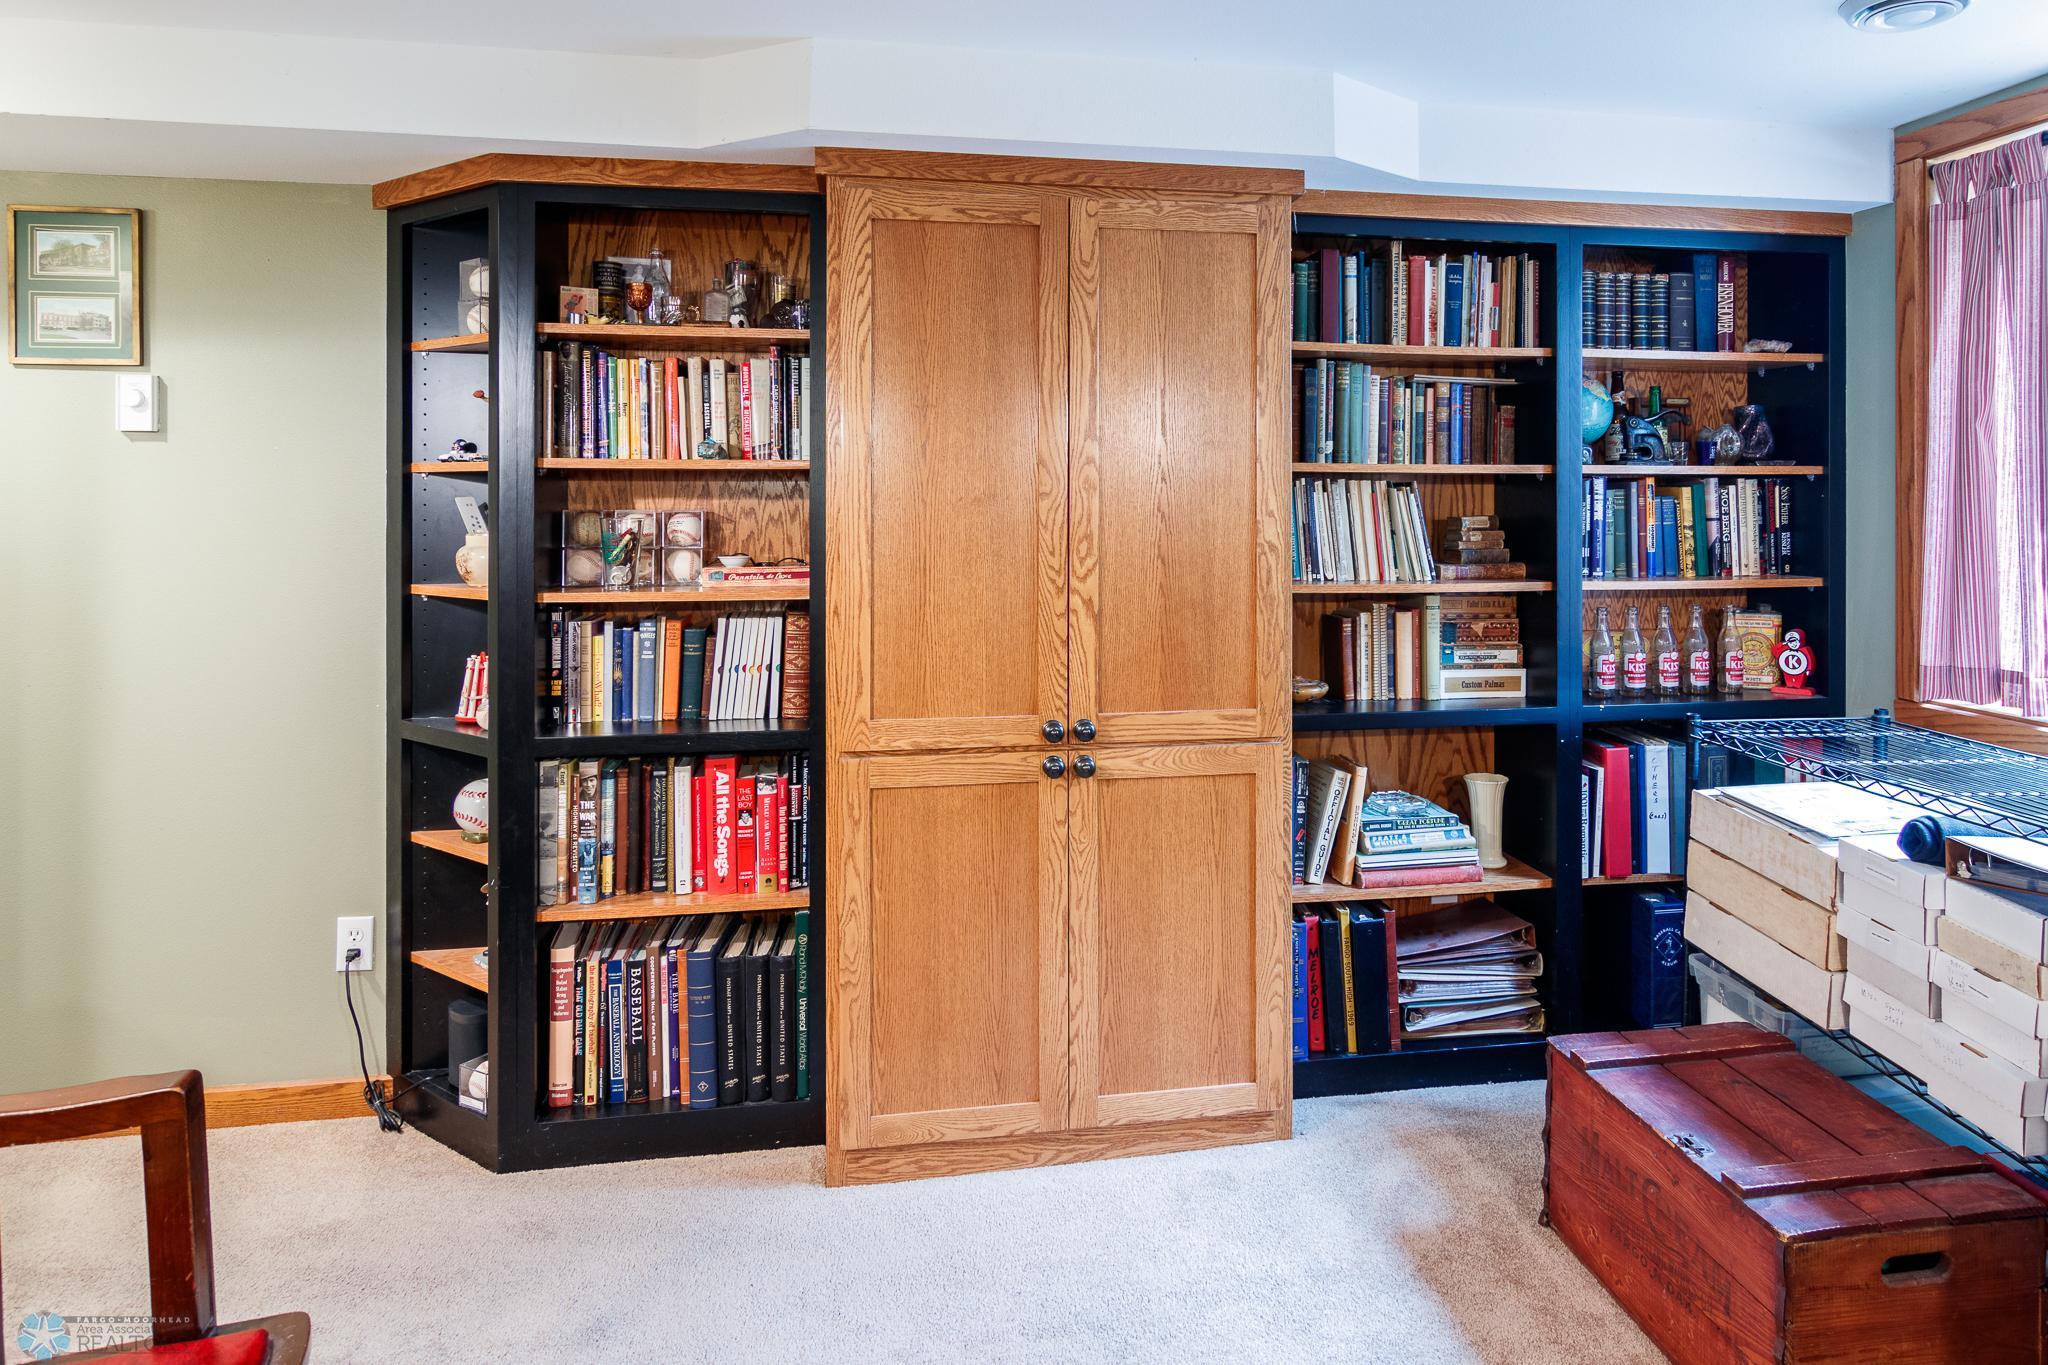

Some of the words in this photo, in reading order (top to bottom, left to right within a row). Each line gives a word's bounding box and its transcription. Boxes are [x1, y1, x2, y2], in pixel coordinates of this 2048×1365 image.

[1393, 287, 1399, 295] ON
[1717, 283, 1734, 334] EISENHOWER
[742, 366, 750, 399] MONEYBALL
[1720, 489, 1729, 514] MOE
[1781, 503, 1790, 525] FATHER
[1722, 515, 1730, 541] BERG
[1788, 655, 1799, 669] K
[1461, 681, 1482, 690] Custom
[1484, 679, 1505, 689] Palmas
[715, 771, 730, 795] All
[580, 801, 596, 809] THE
[716, 796, 730, 824] the
[763, 797, 771, 818] MICKEY
[779, 806, 787, 816] When
[1322, 789, 1341, 841] OFFICIAL
[579, 812, 597, 820] WAR
[713, 825, 731, 877] Songs
[763, 831, 771, 851] WILLIE
[779, 842, 787, 852] Black
[1374, 839, 1407, 848] WHITNEY
[779, 860, 787, 870] White
[1313, 844, 1326, 878] GUIDE
[1653, 928, 1674, 941] BASEBALL
[798, 945, 807, 964] Rand
[1343, 937, 1351, 959] FARGO
[1344, 962, 1352, 984] SOUTH
[1661, 959, 1679, 967] ALBUM
[797, 964, 807, 993] McNally
[1308, 948, 1320, 1021] MELROE
[575, 986, 584, 1003] THAT
[587, 975, 596, 1023] autobiography
[575, 1004, 584, 1018] OLD
[612, 997, 620, 1030] BASEBALL
[631, 967, 642, 1045] BASEBALL
[798, 998, 807, 1031] Universal
[575, 1019, 584, 1035] BALL
[1347, 1010, 1355, 1027] 1969
[574, 1036, 584, 1056] GAME
[588, 1029, 597, 1055] baseball
[798, 1032, 807, 1052] World
[612, 1032, 621, 1075] ANTHOLOGY
[799, 1053, 807, 1070] Atlas
